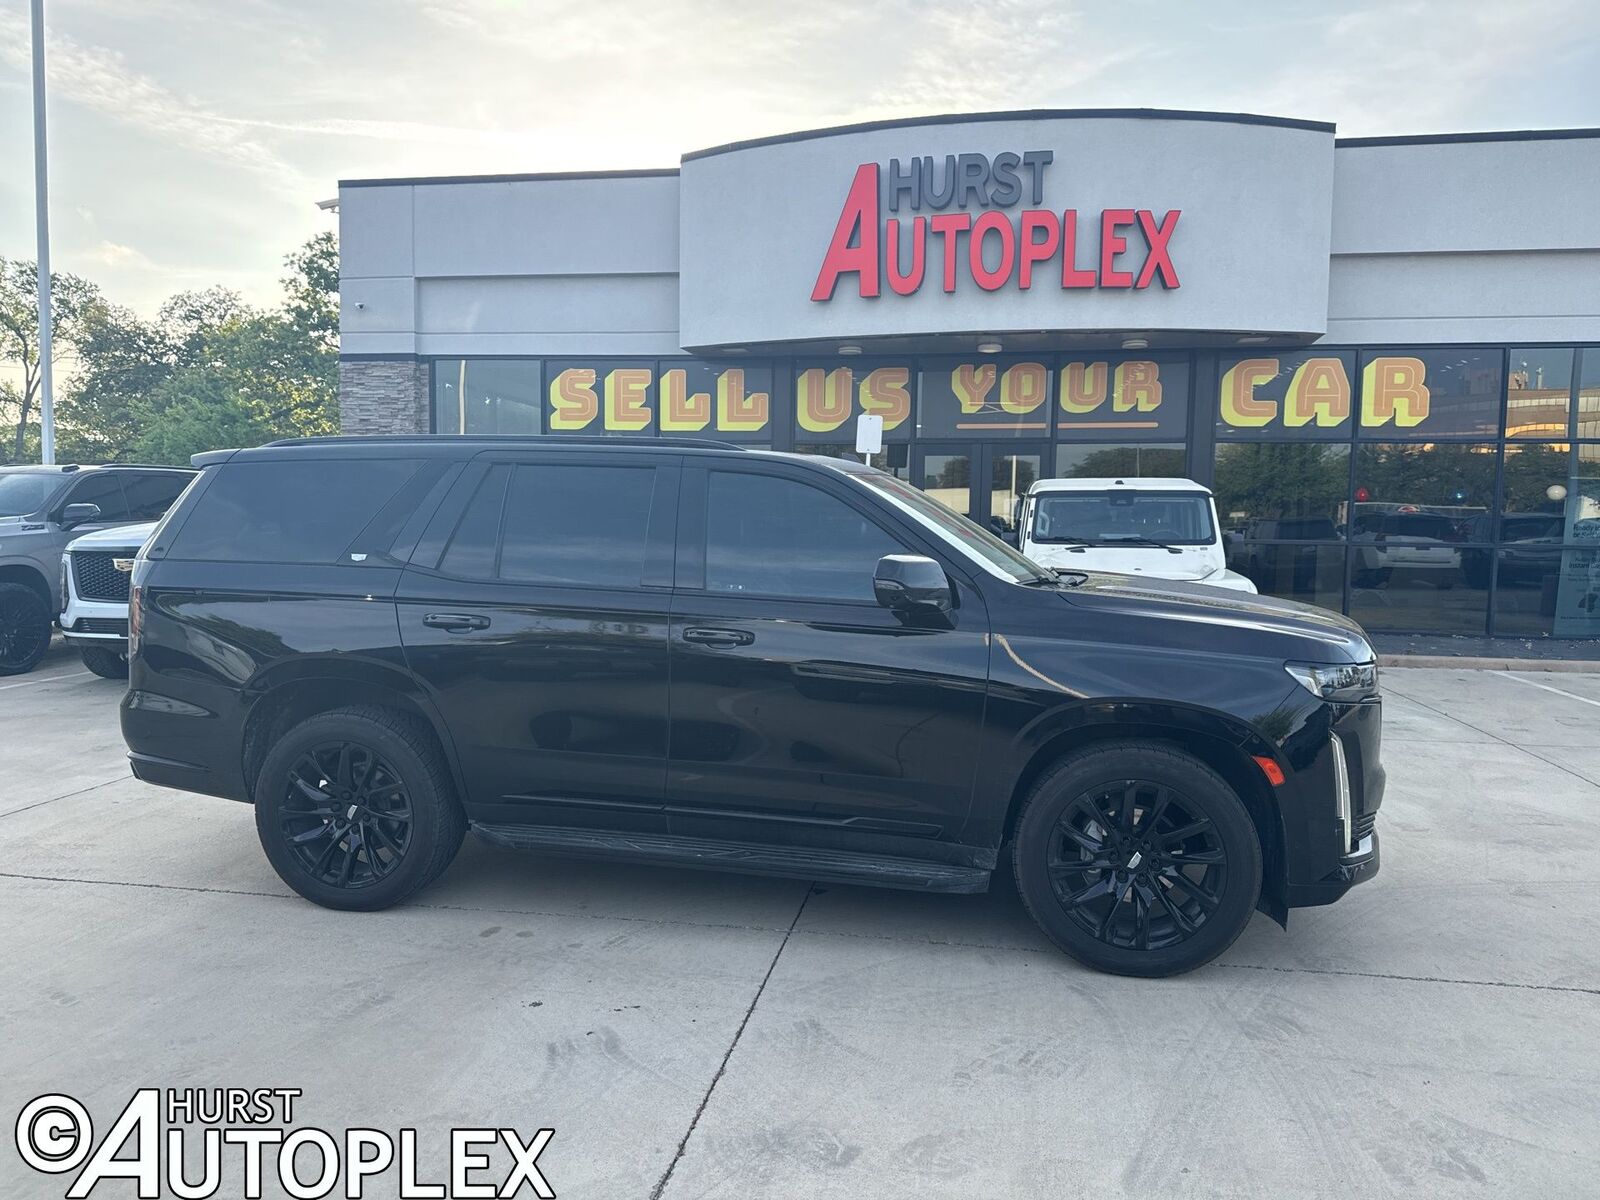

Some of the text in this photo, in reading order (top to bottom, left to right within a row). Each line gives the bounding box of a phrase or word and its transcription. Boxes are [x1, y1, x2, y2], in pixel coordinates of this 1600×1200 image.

[889, 150, 1054, 212] HURST
[810, 162, 1182, 302] AUTOPLEX
[549, 357, 1430, 433] SELL US YOUR CAR
